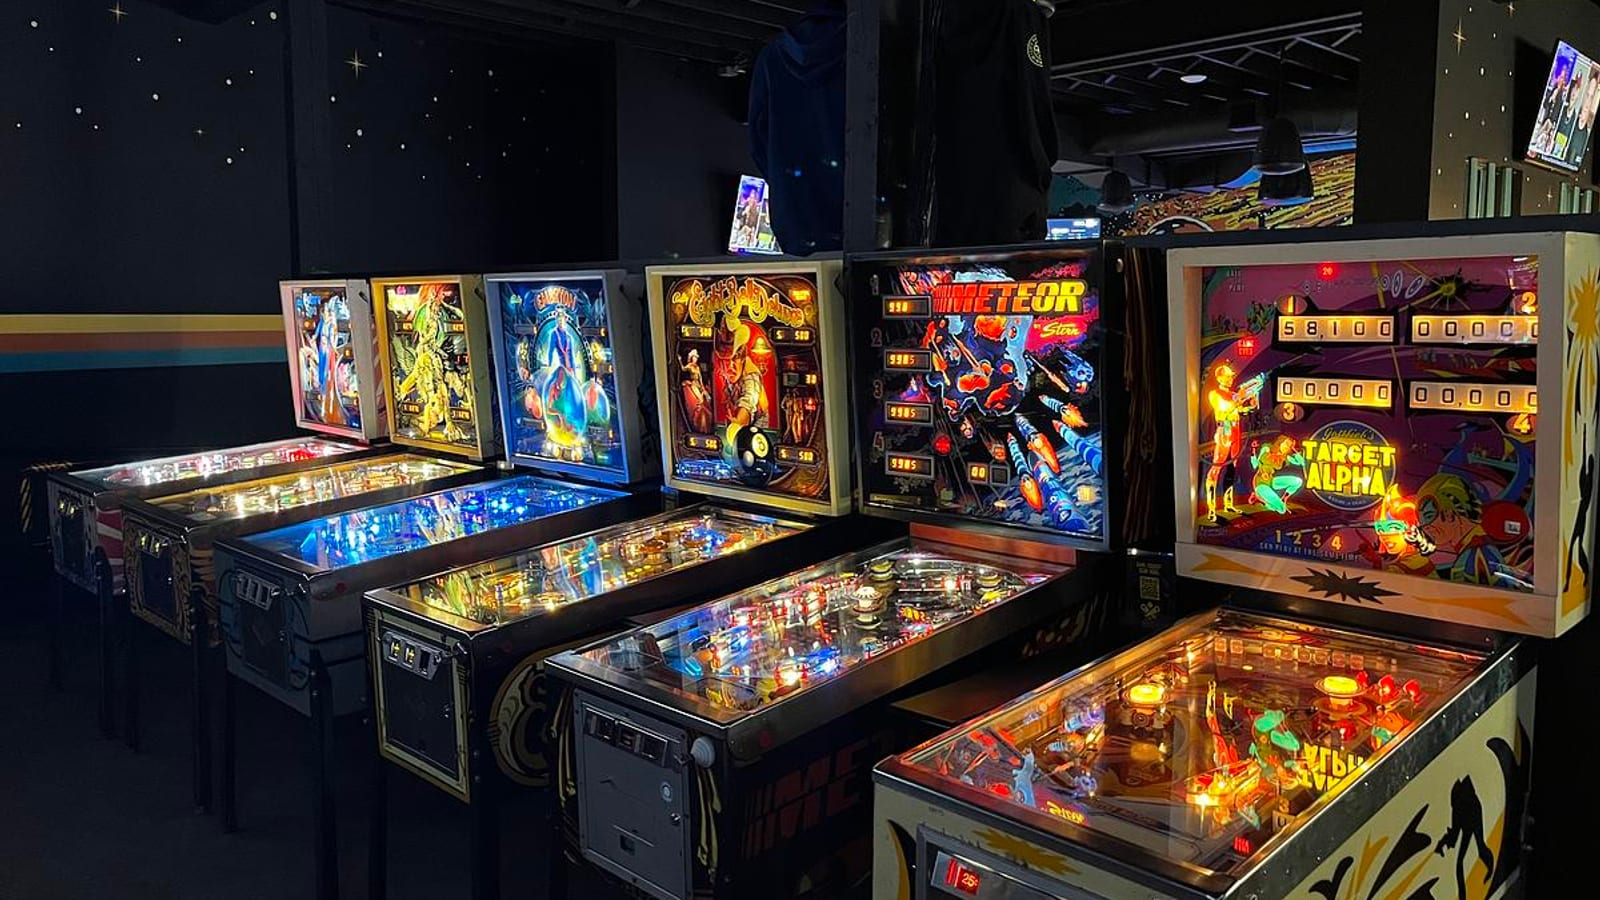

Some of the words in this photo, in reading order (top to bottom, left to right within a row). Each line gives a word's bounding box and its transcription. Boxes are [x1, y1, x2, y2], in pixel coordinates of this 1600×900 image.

[936, 282, 1085, 313] METEOR
[1287, 295, 1295, 313] 1
[1521, 291, 1537, 314] 2
[1040, 321, 1080, 338] Stern
[1284, 321, 1391, 339] 58,100
[1283, 382, 1389, 401] 00,000
[1282, 402, 1295, 420] 3
[1513, 413, 1531, 434] 4
[1322, 427, 1375, 441] Gottlieb's
[1302, 440, 1396, 467] TARGET
[1306, 462, 1386, 496] ALPHA
[1275, 529, 1282, 544] 1
[1312, 534, 1321, 548] 3
[1331, 534, 1342, 550] 4
